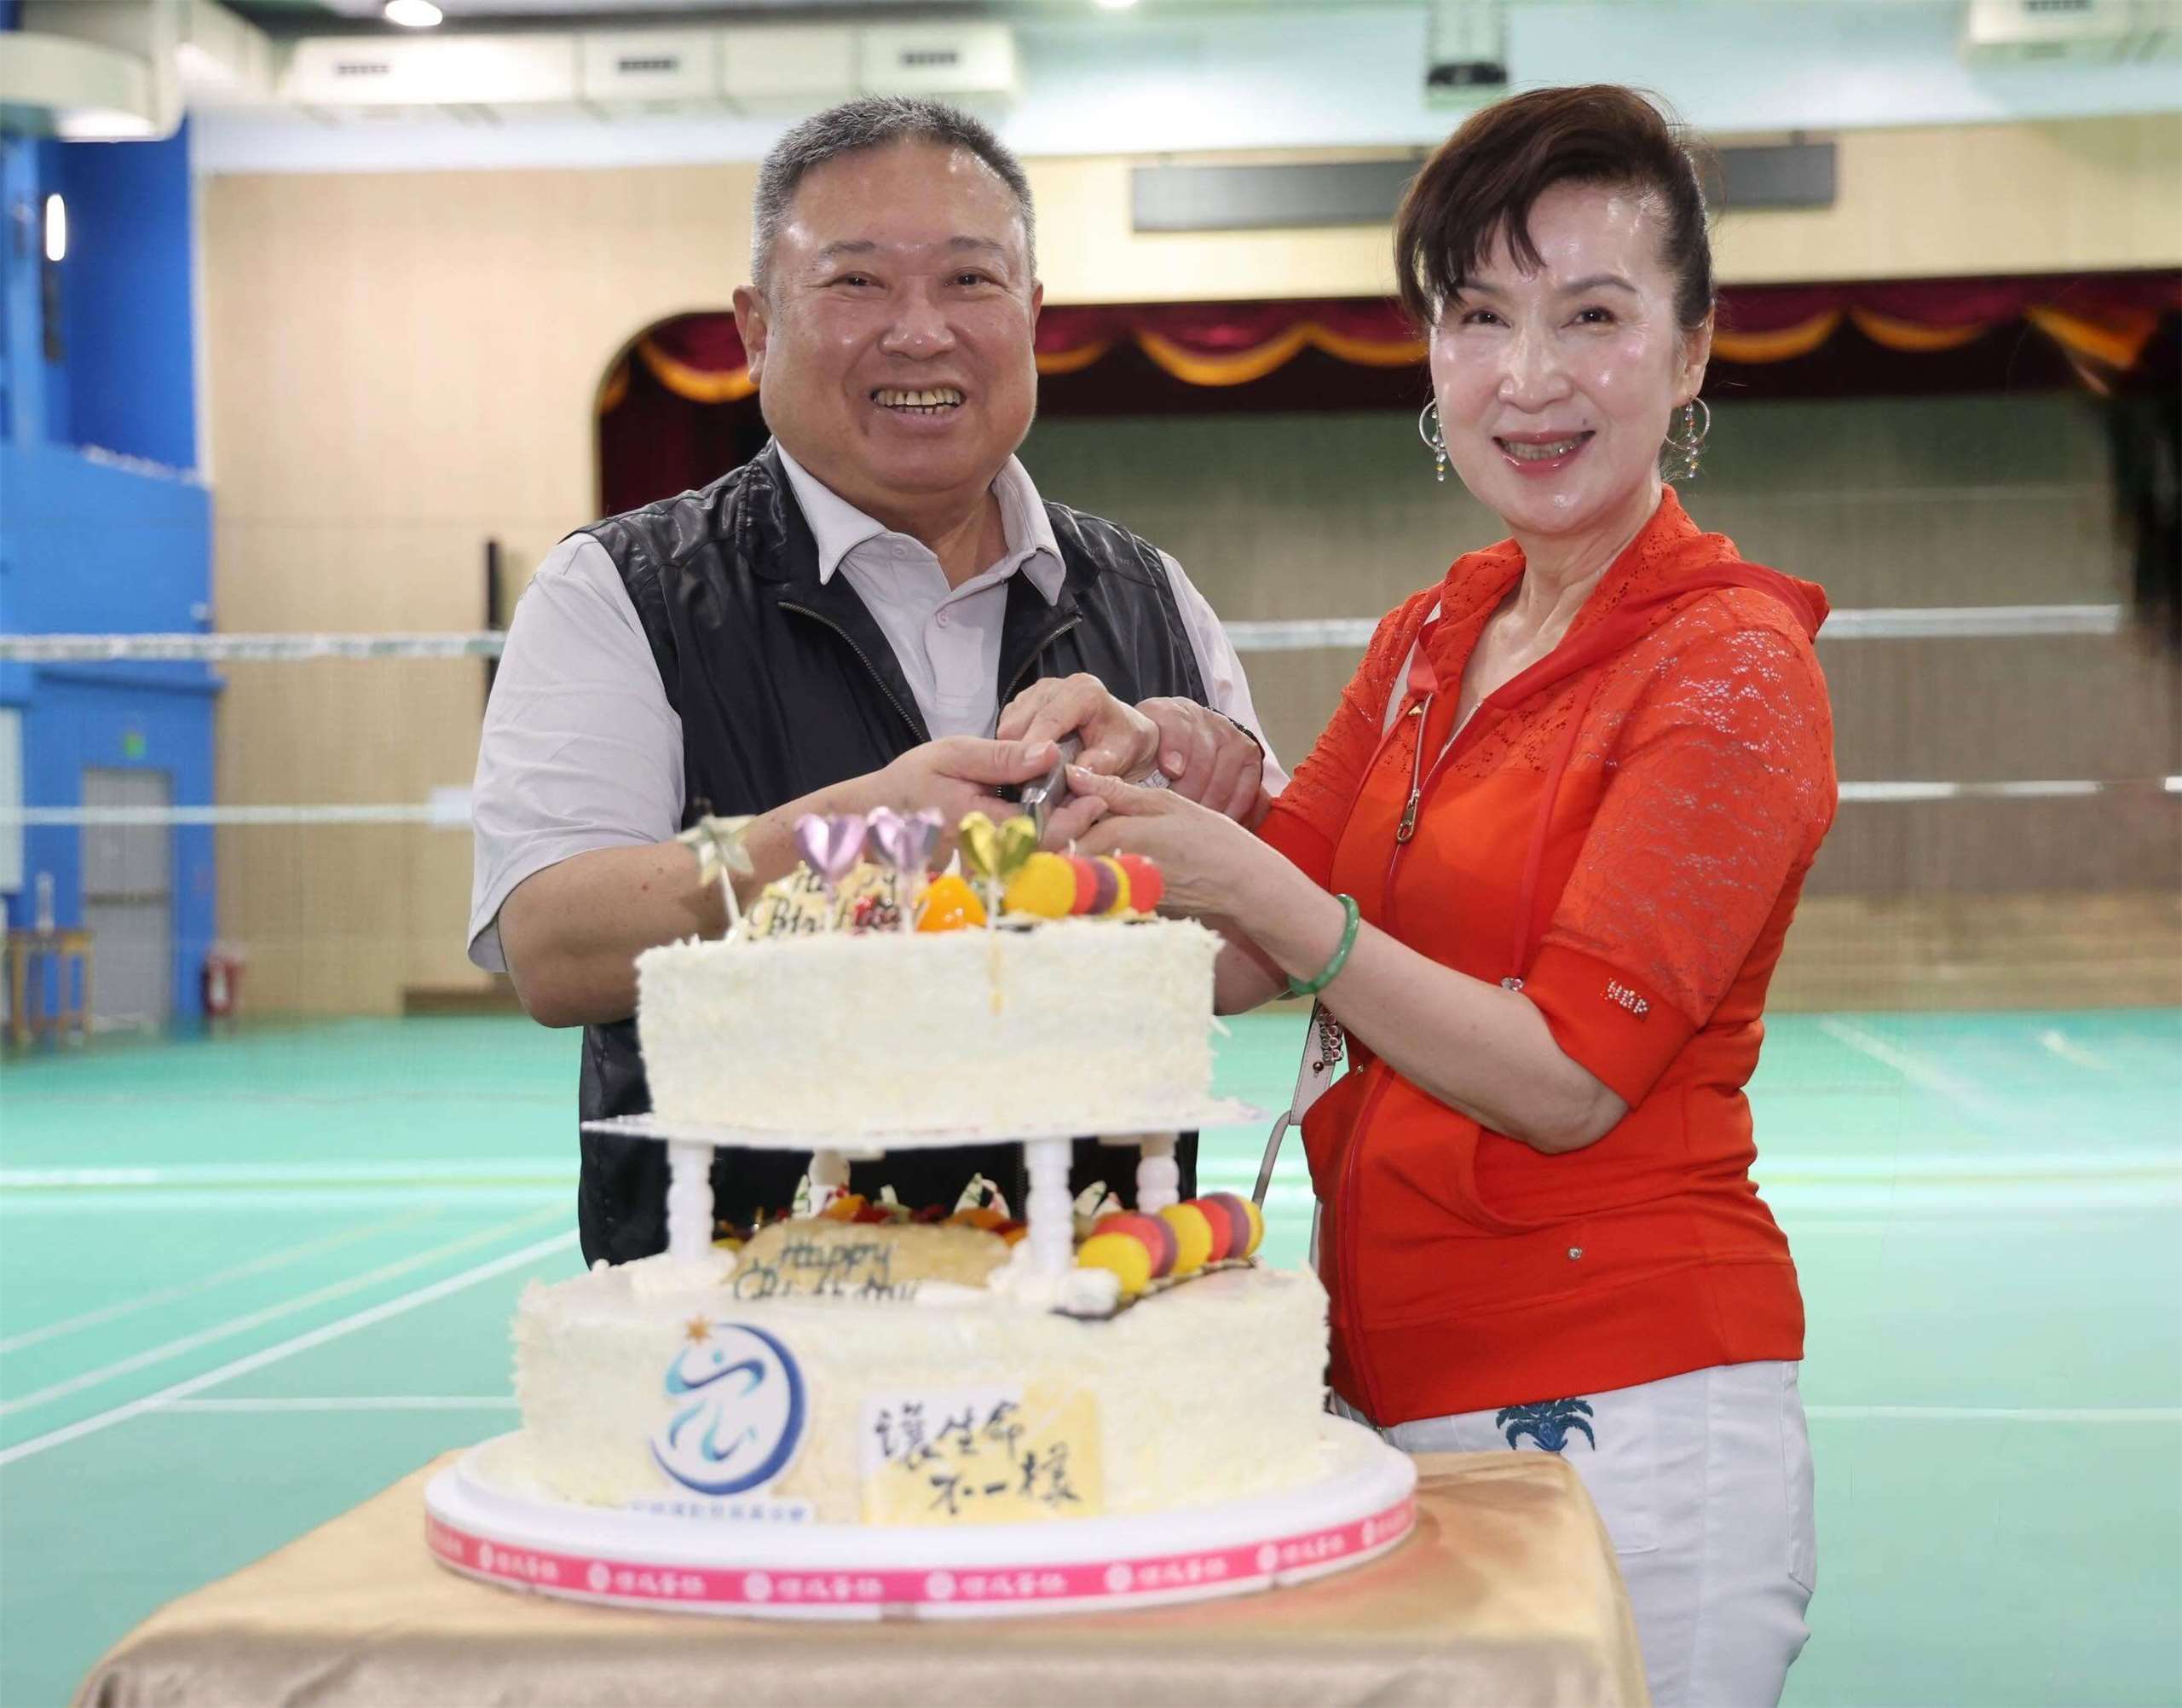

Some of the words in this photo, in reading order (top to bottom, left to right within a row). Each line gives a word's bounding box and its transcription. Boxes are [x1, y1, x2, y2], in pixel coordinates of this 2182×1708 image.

[778, 1237, 893, 1281] Happy
[929, 1439, 1082, 1516] 不一樣
